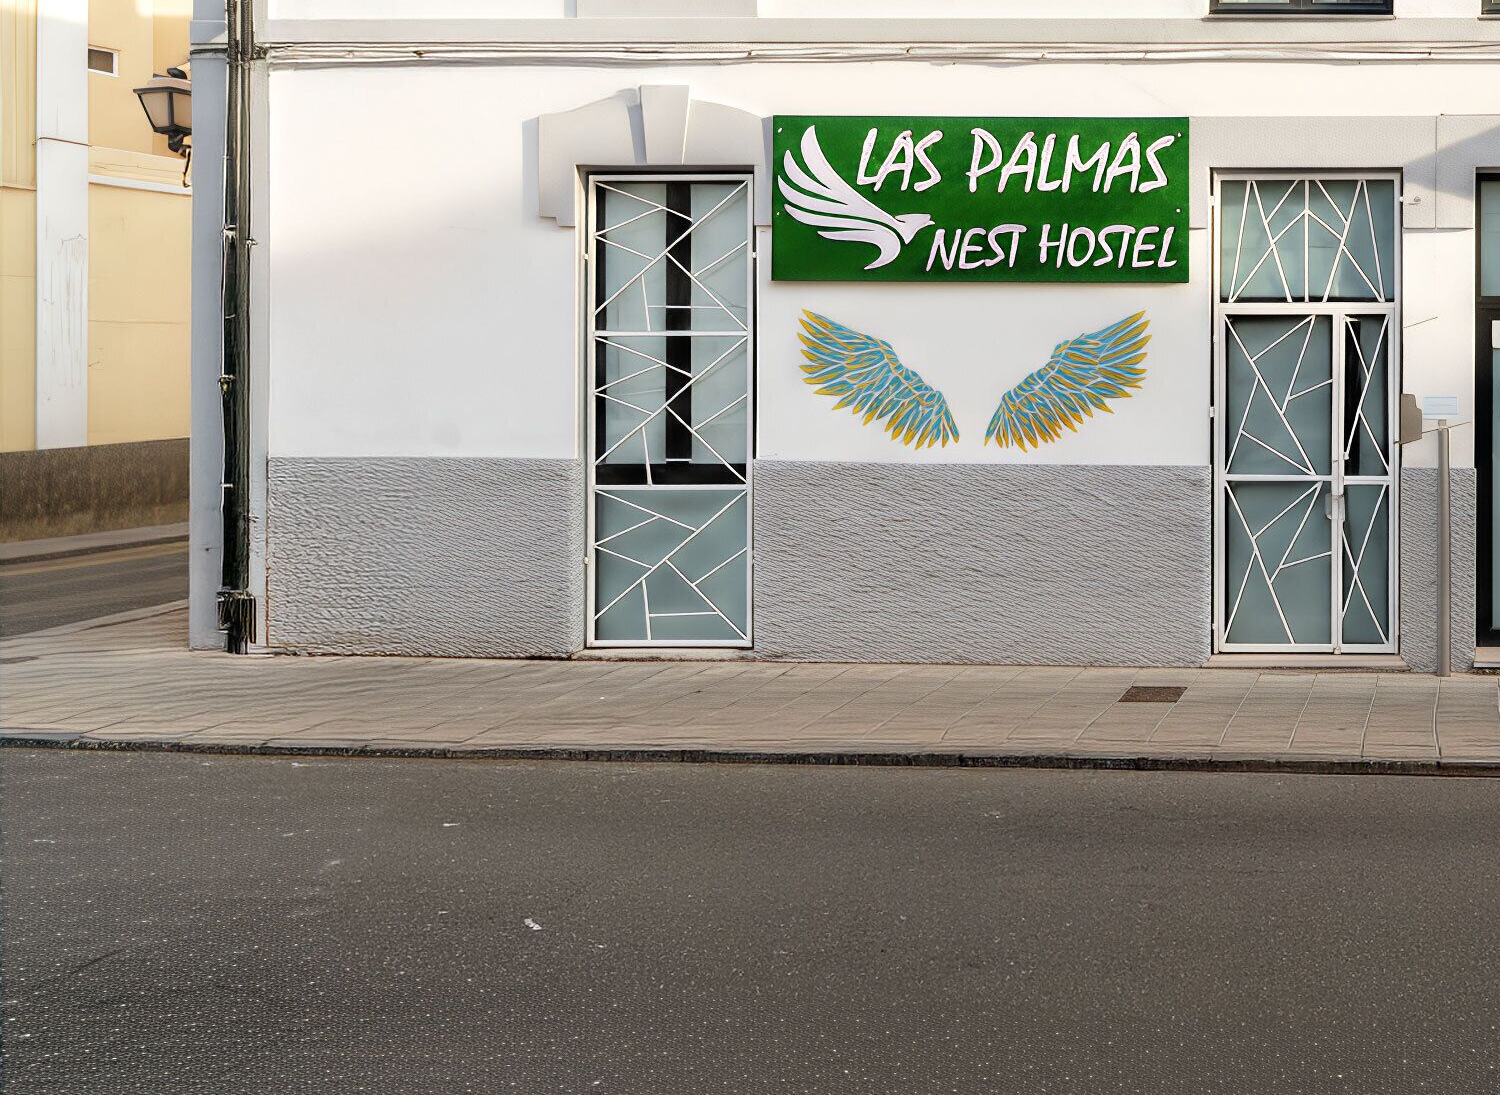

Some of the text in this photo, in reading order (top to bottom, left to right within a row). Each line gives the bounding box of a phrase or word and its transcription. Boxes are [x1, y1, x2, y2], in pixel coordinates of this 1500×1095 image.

[857, 128, 1175, 193] LAS PALMAS
[925, 223, 1178, 271] NEST HOSTEL
